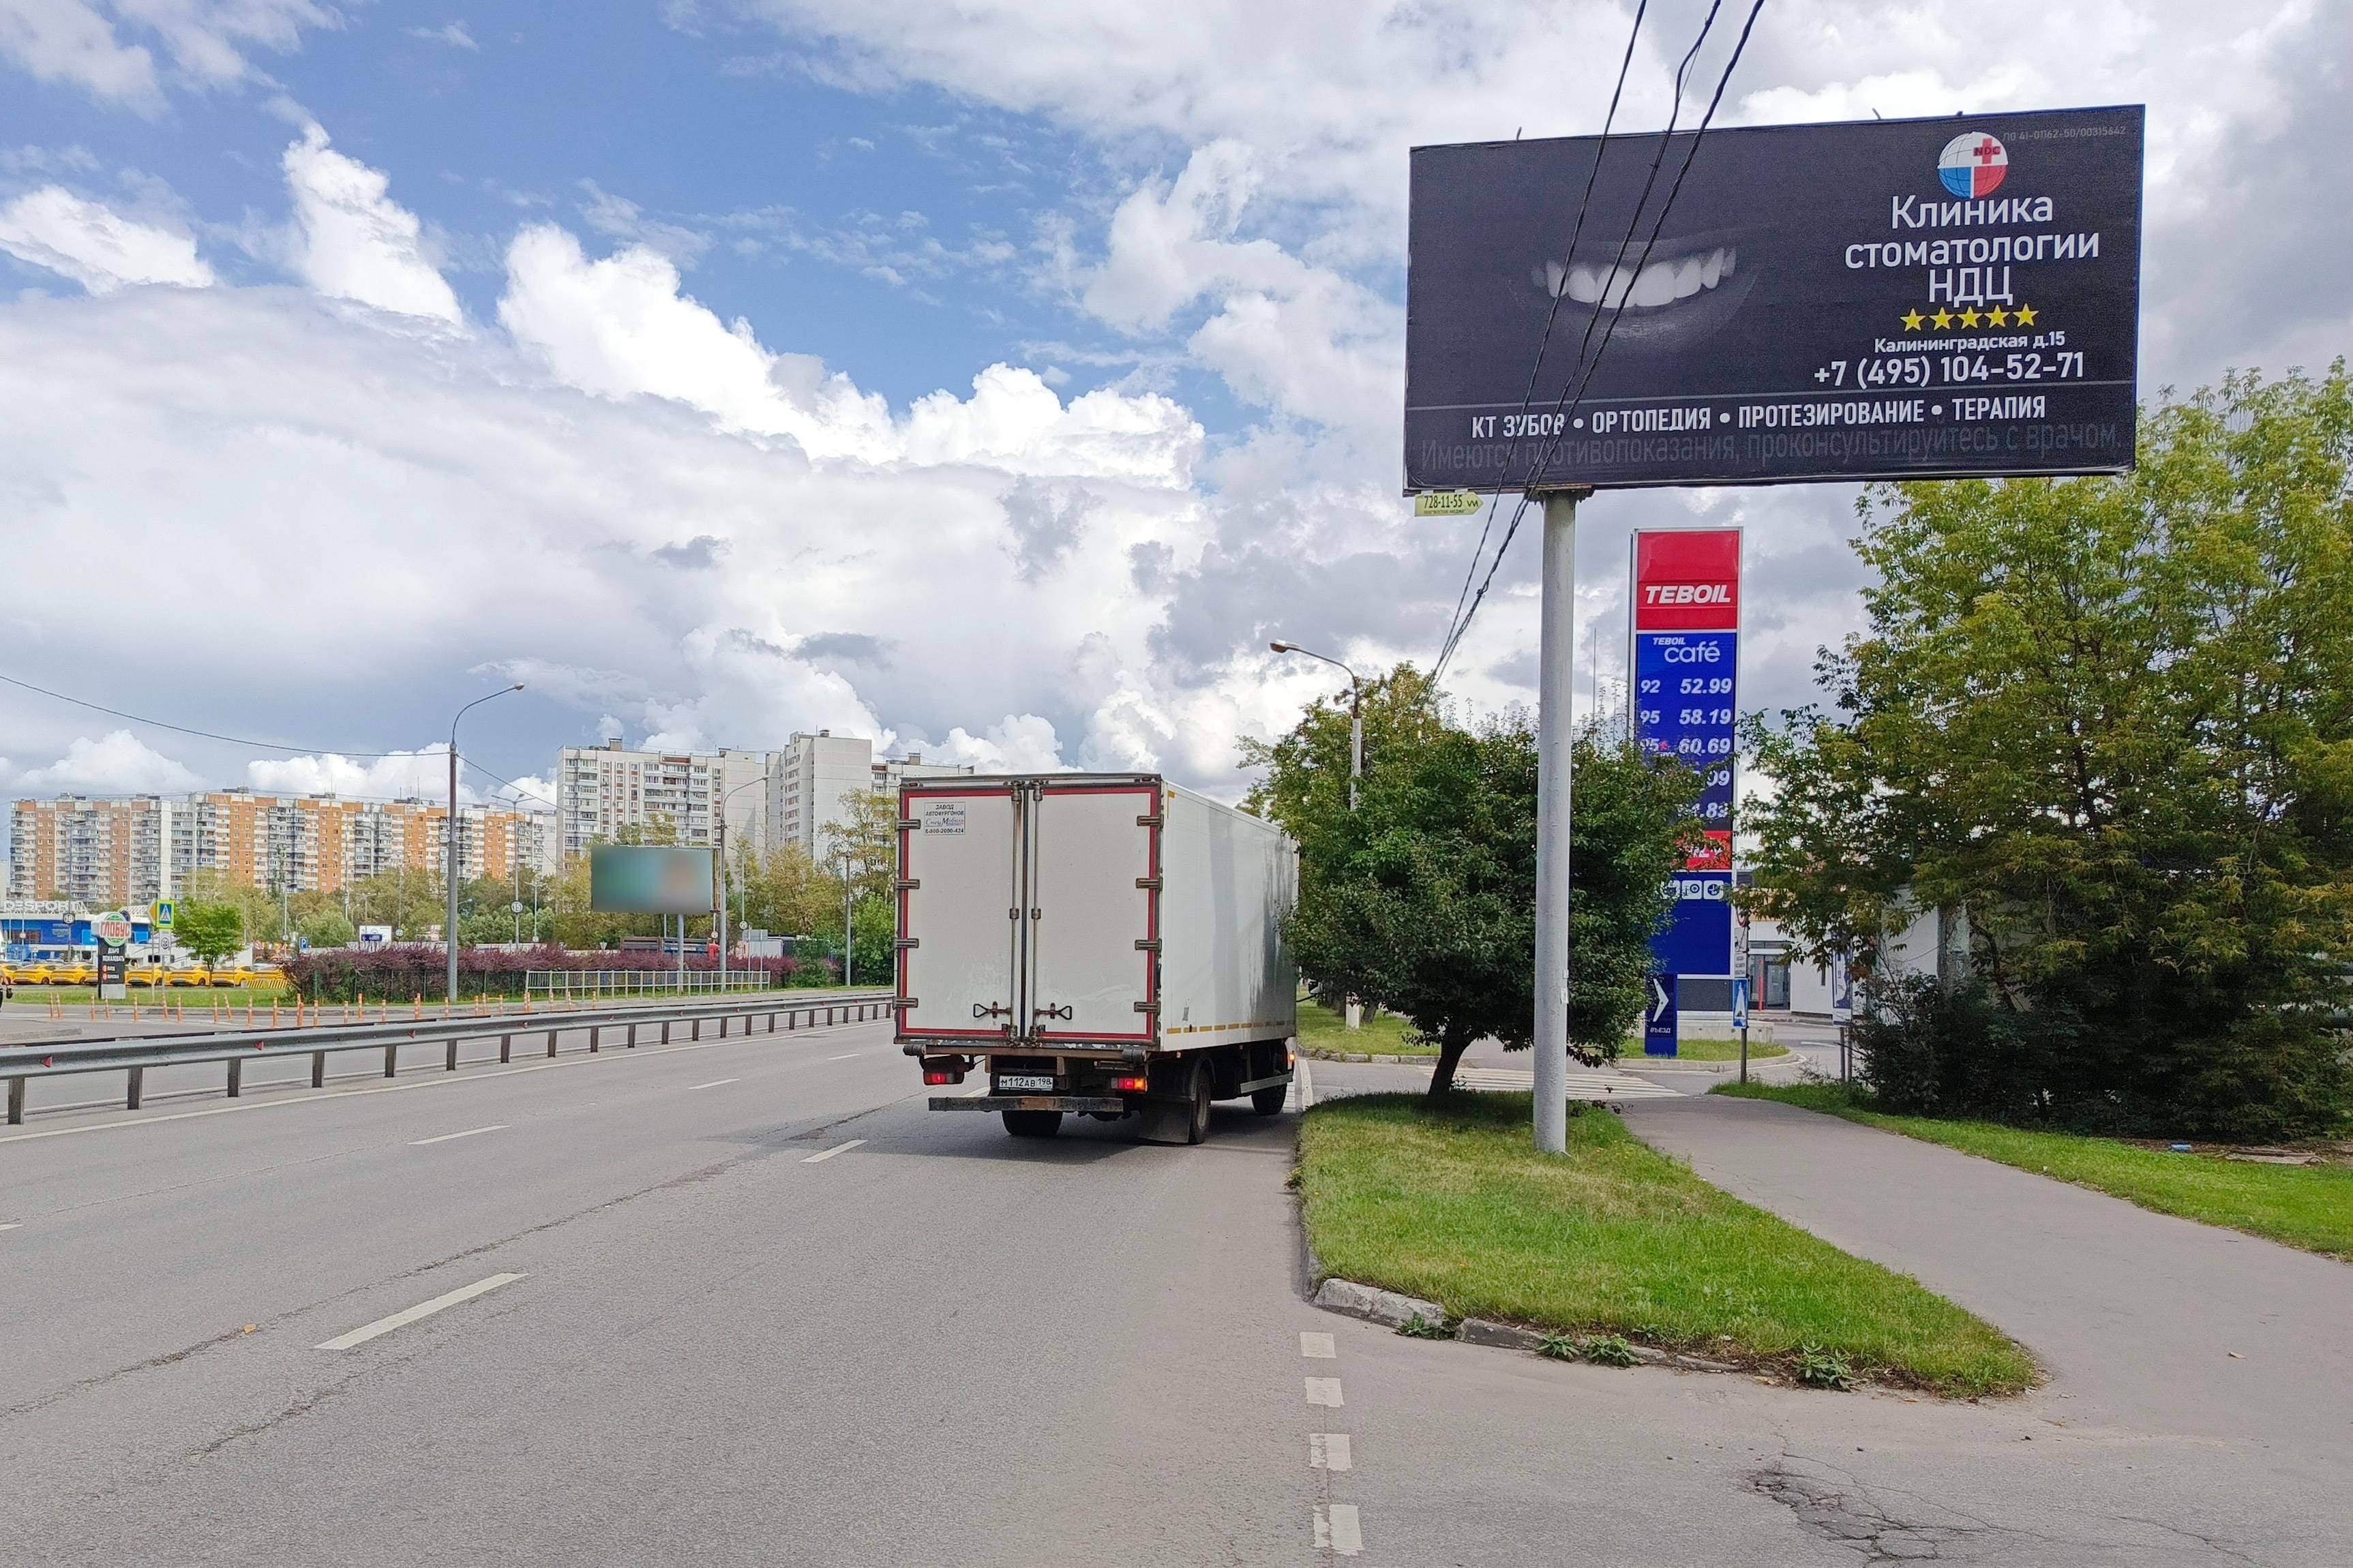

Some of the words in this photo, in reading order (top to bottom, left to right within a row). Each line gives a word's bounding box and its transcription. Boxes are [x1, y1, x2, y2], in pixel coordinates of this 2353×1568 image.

[1974, 146, 2000, 156] NDC
[1891, 195, 2053, 229] Клиника
[1845, 232, 2099, 269] стоматологии
[1929, 266, 2013, 308] НДЦ
[1874, 334, 2028, 353] Калининградская
[2033, 331, 2065, 349] д.15
[1814, 361, 1847, 387] +7
[1857, 356, 1931, 389] (495)
[1940, 352, 2084, 382] 104-52-71
[1471, 416, 1497, 438] КТ
[1503, 413, 1565, 437] ЗУБОВ
[1592, 408, 1711, 433] ОРТОПЕДИЯ
[1738, 399, 1925, 428] ПРОТЕЗИРОВАНИЕ
[1951, 395, 2045, 421] ТЕРАПИЯ
[1421, 439, 1518, 471] Имеются
[1748, 417, 1998, 466] проконсультируйтесь
[1645, 584, 1731, 604] TEBOIL
[1653, 637, 1686, 646] TEBOIL
[1664, 640, 1720, 663] café
[1640, 680, 1660, 693] 92
[1679, 678, 1732, 694] 52.99
[1640, 710, 1660, 724] 95
[1679, 708, 1731, 725] 58.19
[1679, 738, 1730, 755] 60.69
[101, 921, 130, 937] ГЛОБУС
